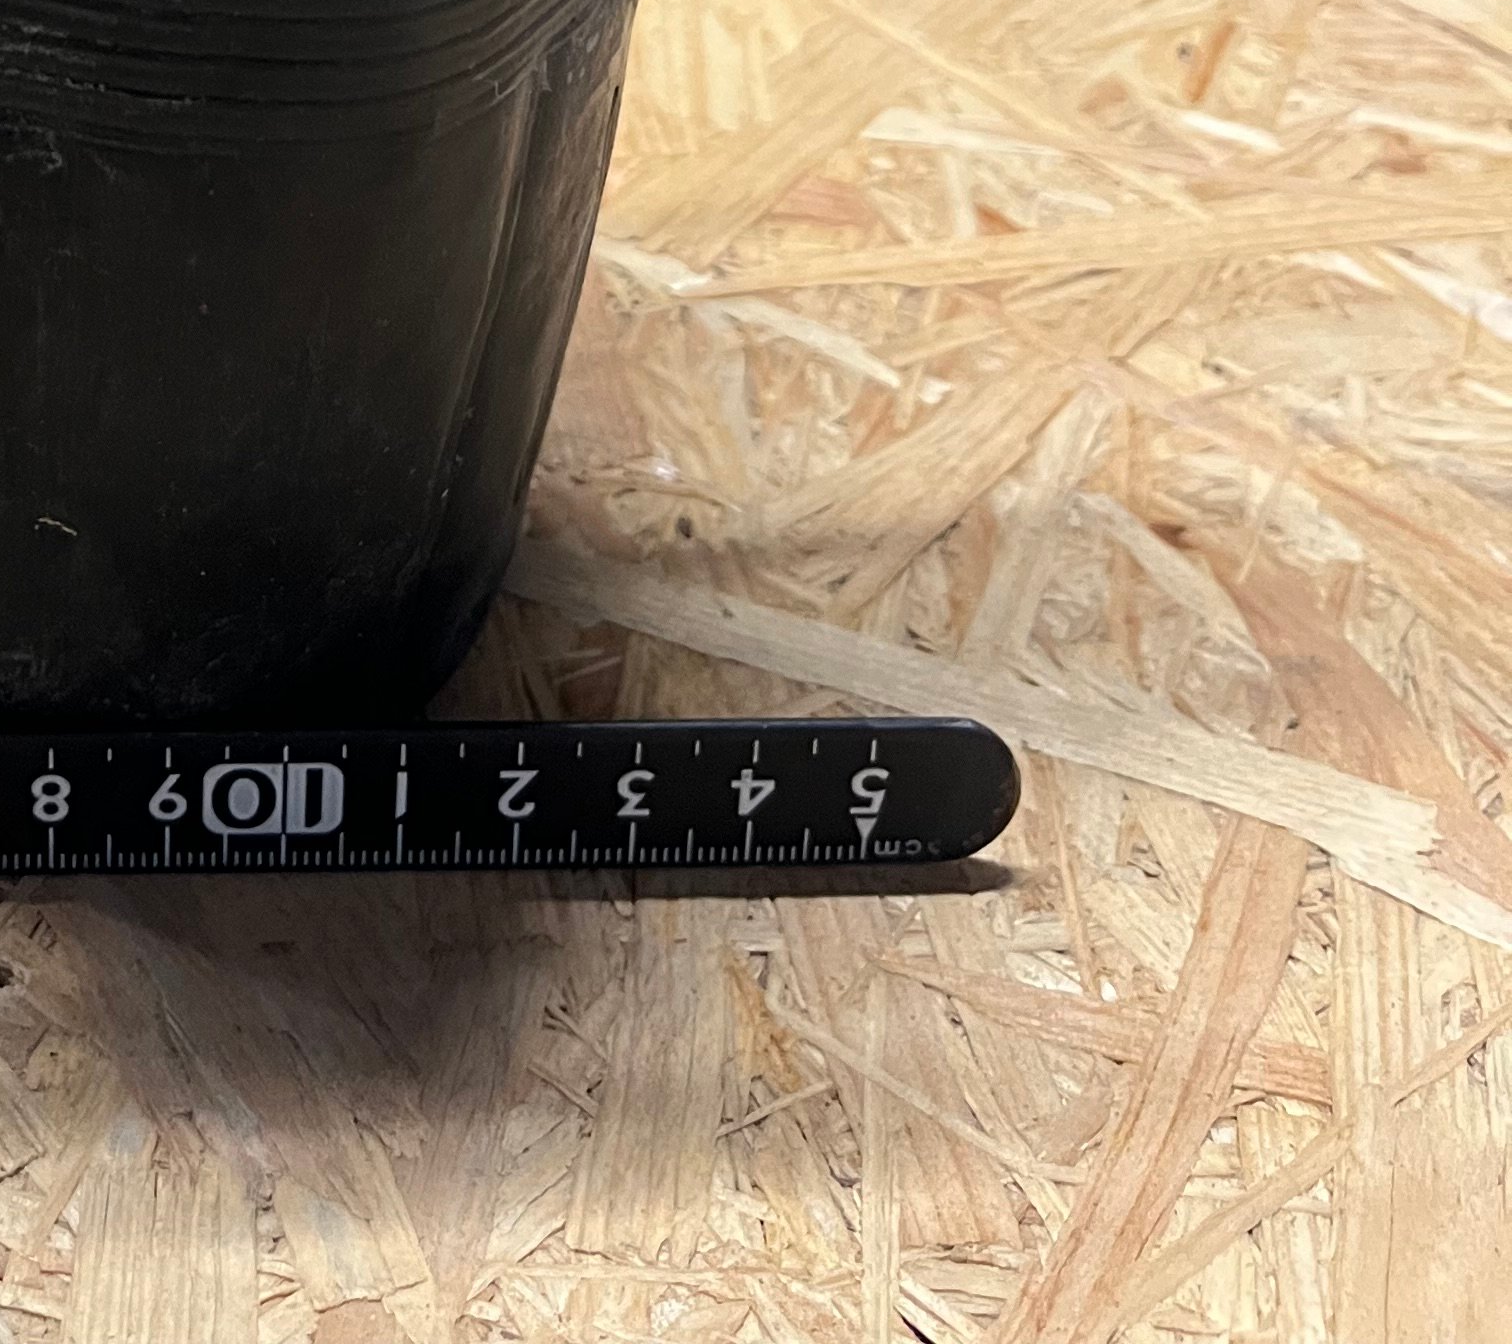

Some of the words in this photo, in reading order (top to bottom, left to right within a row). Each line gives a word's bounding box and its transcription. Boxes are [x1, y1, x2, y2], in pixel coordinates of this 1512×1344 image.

[32, 775, 70, 821] 8
[149, 774, 186, 819] 9
[211, 768, 324, 829] 10
[499, 771, 538, 817] 2
[618, 771, 654, 816] 3
[731, 769, 775, 815] 4
[850, 768, 889, 814] 5
